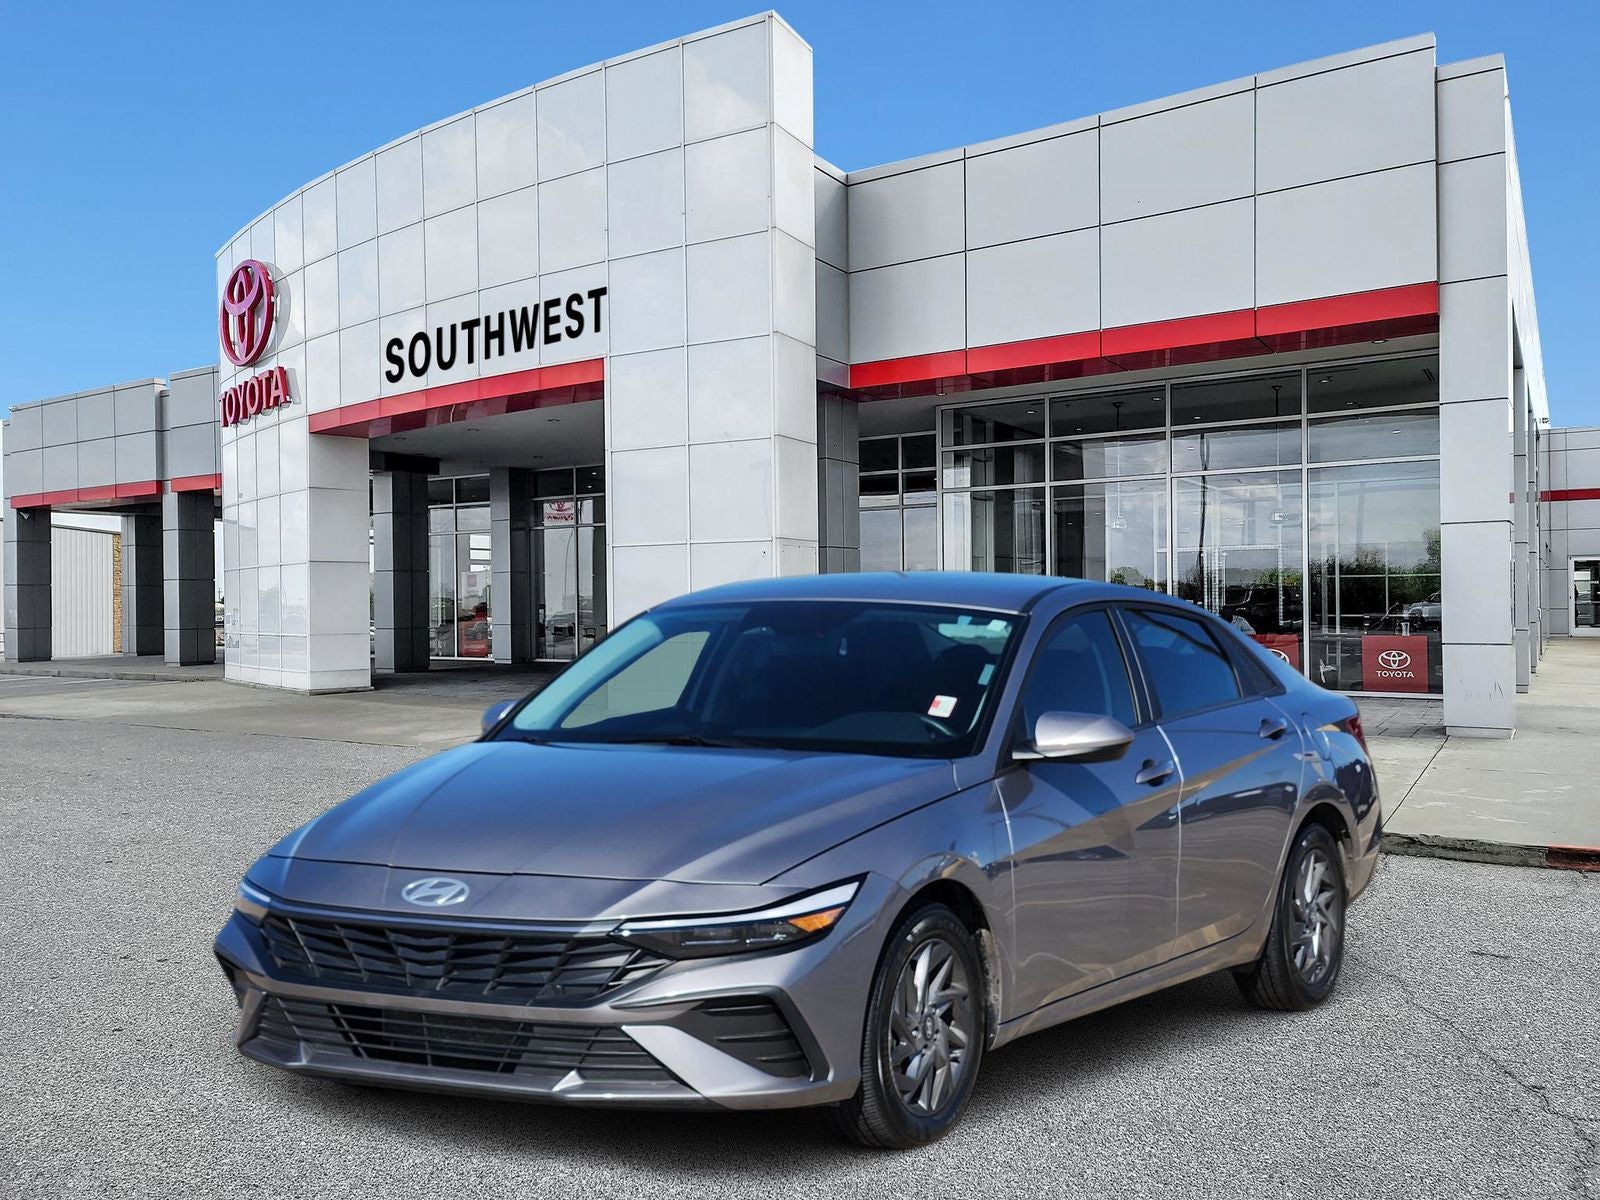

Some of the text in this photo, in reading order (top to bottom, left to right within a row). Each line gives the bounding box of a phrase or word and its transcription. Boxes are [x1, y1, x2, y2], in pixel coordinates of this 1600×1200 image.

[385, 286, 607, 384] SOUTHWEST
[219, 366, 291, 428] TOYOTA
[1376, 670, 1415, 678] TOYOTA
